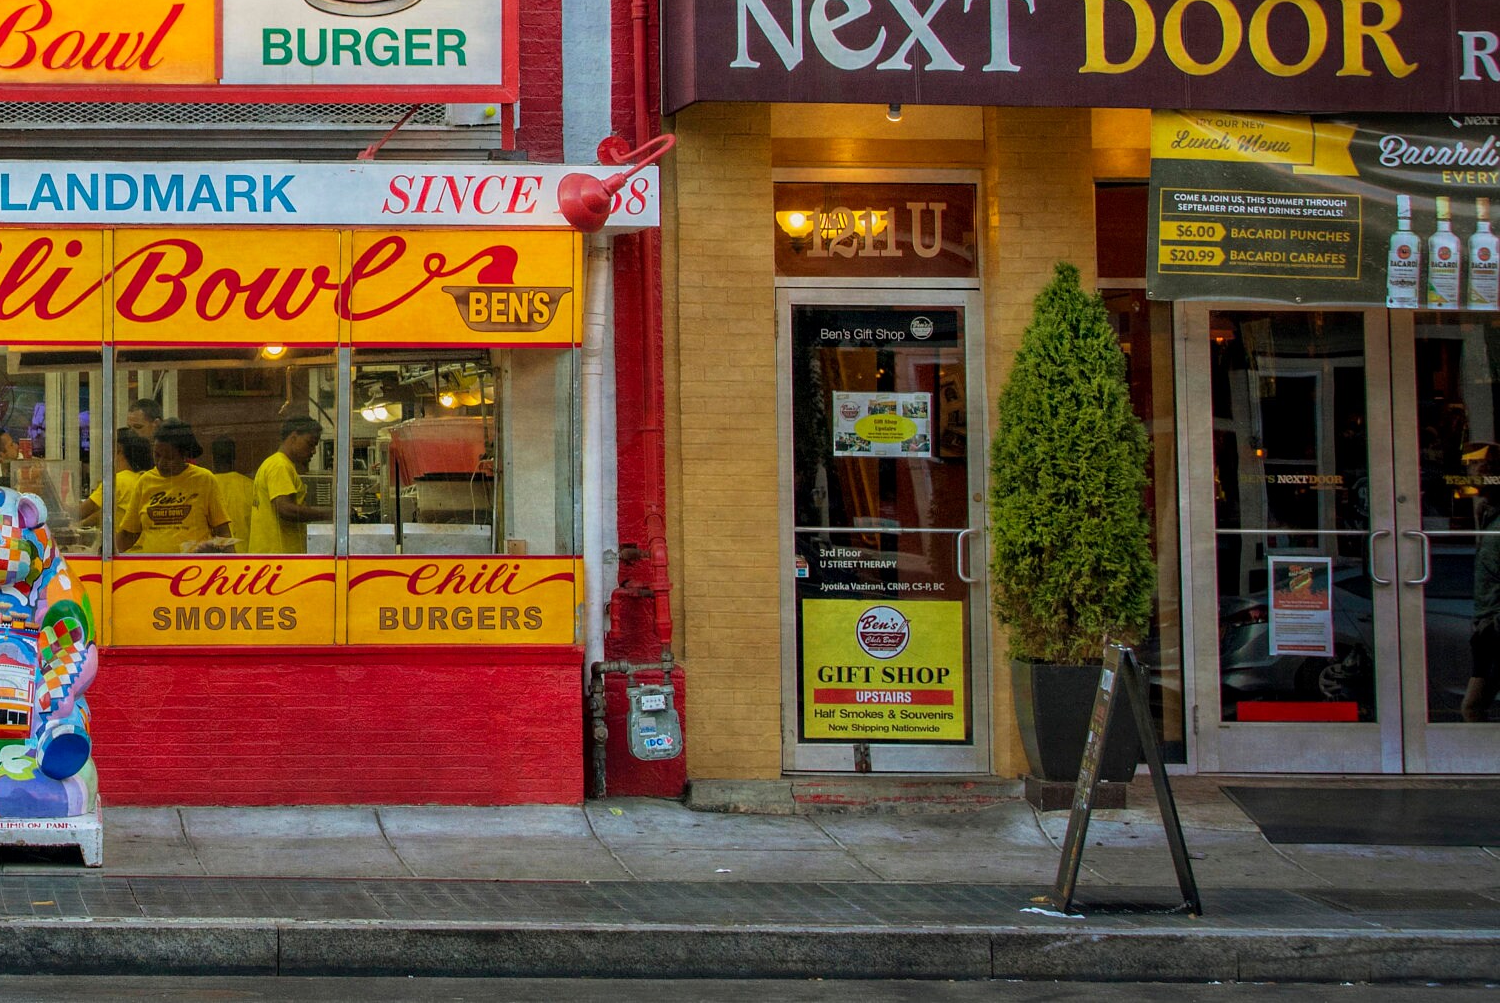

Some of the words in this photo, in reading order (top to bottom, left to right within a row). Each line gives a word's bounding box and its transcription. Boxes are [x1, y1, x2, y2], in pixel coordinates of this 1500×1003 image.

[262, 27, 467, 67] BURGER
[1215, 119, 1239, 128] OUR
[1241, 120, 1265, 129] NEW
[1171, 130, 1232, 151] Lunch
[1237, 134, 1292, 153] Menu
[1379, 135, 1500, 167] Bacardi
[1442, 170, 1499, 184] EVERY
[0, 173, 297, 213] LANDMARK
[381, 174, 544, 215] SINCE
[1174, 193, 1199, 202] COME
[1208, 194, 1230, 203] JOIN
[1231, 195, 1245, 205] US,
[1246, 196, 1265, 205] THIS
[1266, 197, 1303, 207] SUMMER
[1305, 198, 1347, 208] THROUGH
[1177, 203, 1226, 213] SEPTEMBER
[1228, 205, 1245, 214] FOR
[1247, 205, 1267, 214] NEW
[1268, 206, 1301, 216] DRINKS
[1302, 207, 1344, 217] SPECIALS!
[806, 206, 902, 258] 1211
[906, 202, 947, 258] U
[1176, 224, 1216, 239] $6.00
[1231, 228, 1287, 240] BACARDI
[1290, 230, 1351, 243] PUNCHES
[1170, 249, 1215, 263] $20.99
[1230, 250, 1286, 263] BACARDI
[1289, 251, 1347, 264] CARAFES
[1390, 260, 1417, 268] BACARDI
[116, 235, 428, 324] Bowl
[468, 291, 551, 324] BEN'S
[820, 328, 851, 340] Ben's
[853, 328, 873, 340] Gift
[876, 328, 905, 342] Shop
[150, 492, 186, 506] Ben's
[819, 548, 836, 558] 3rd
[837, 548, 862, 558] Floor
[819, 560, 827, 569] U
[827, 560, 857, 569] STREET
[858, 560, 897, 569] THERAPY
[169, 564, 287, 597] Chili
[406, 563, 524, 596] Chili
[819, 582, 850, 592] Jyotika
[850, 582, 886, 592] Vazirani,
[887, 582, 911, 592] CRNP,
[933, 582, 945, 591] BC
[152, 605, 298, 631] SMOKES
[379, 605, 543, 631] BURGERS
[860, 614, 899, 630] Ben's
[817, 665, 875, 683] GIFT
[881, 666, 950, 684] SHOP
[856, 691, 912, 704] UPSTAIRS
[814, 708, 836, 719] Half
[839, 709, 884, 719] Smokes
[887, 709, 896, 719] &
[900, 709, 954, 720] Souvenirs
[828, 723, 848, 732] Now
[851, 723, 890, 733] Shipping
[891, 724, 940, 733] Nationwide
